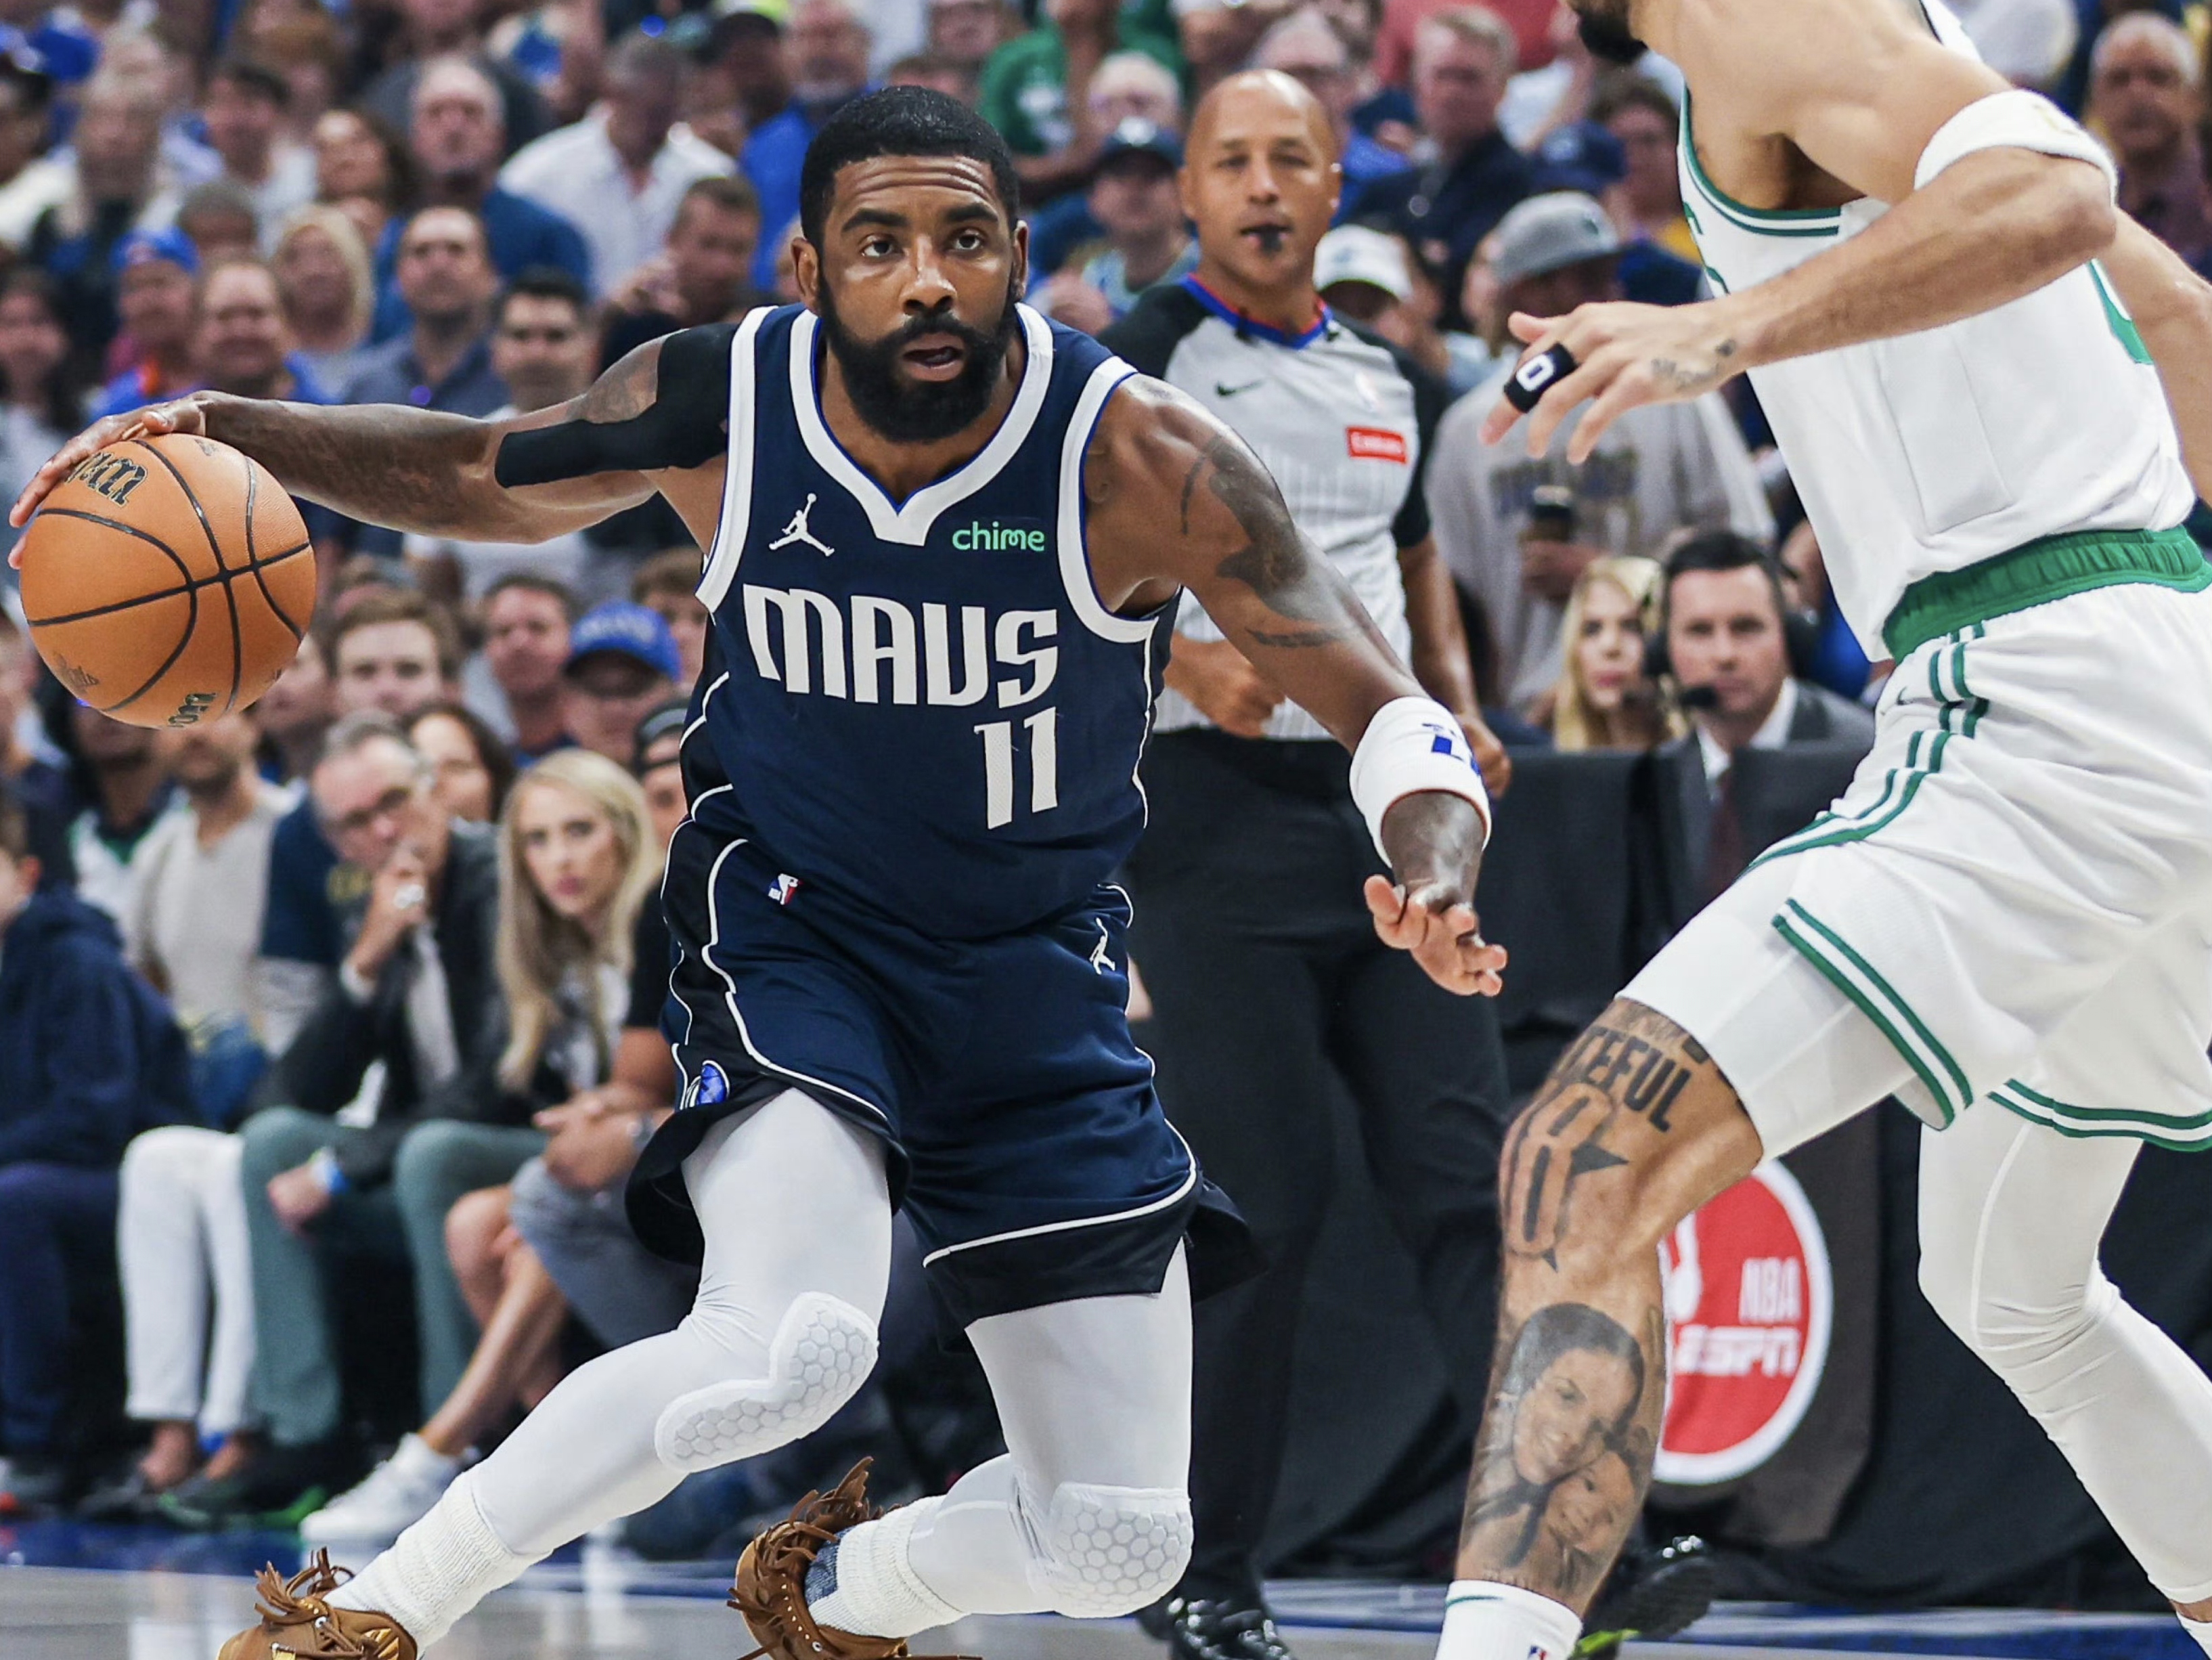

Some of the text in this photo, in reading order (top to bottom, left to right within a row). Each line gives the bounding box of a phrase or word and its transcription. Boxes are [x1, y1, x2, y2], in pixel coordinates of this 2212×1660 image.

[1516, 353, 1554, 391] 0
[952, 521, 1045, 552] chime
[743, 584, 1058, 708] MAVS
[973, 706, 1058, 829] 11
[1739, 1257, 1802, 1324] NBA
[1675, 1324, 1801, 1378] ESPN
